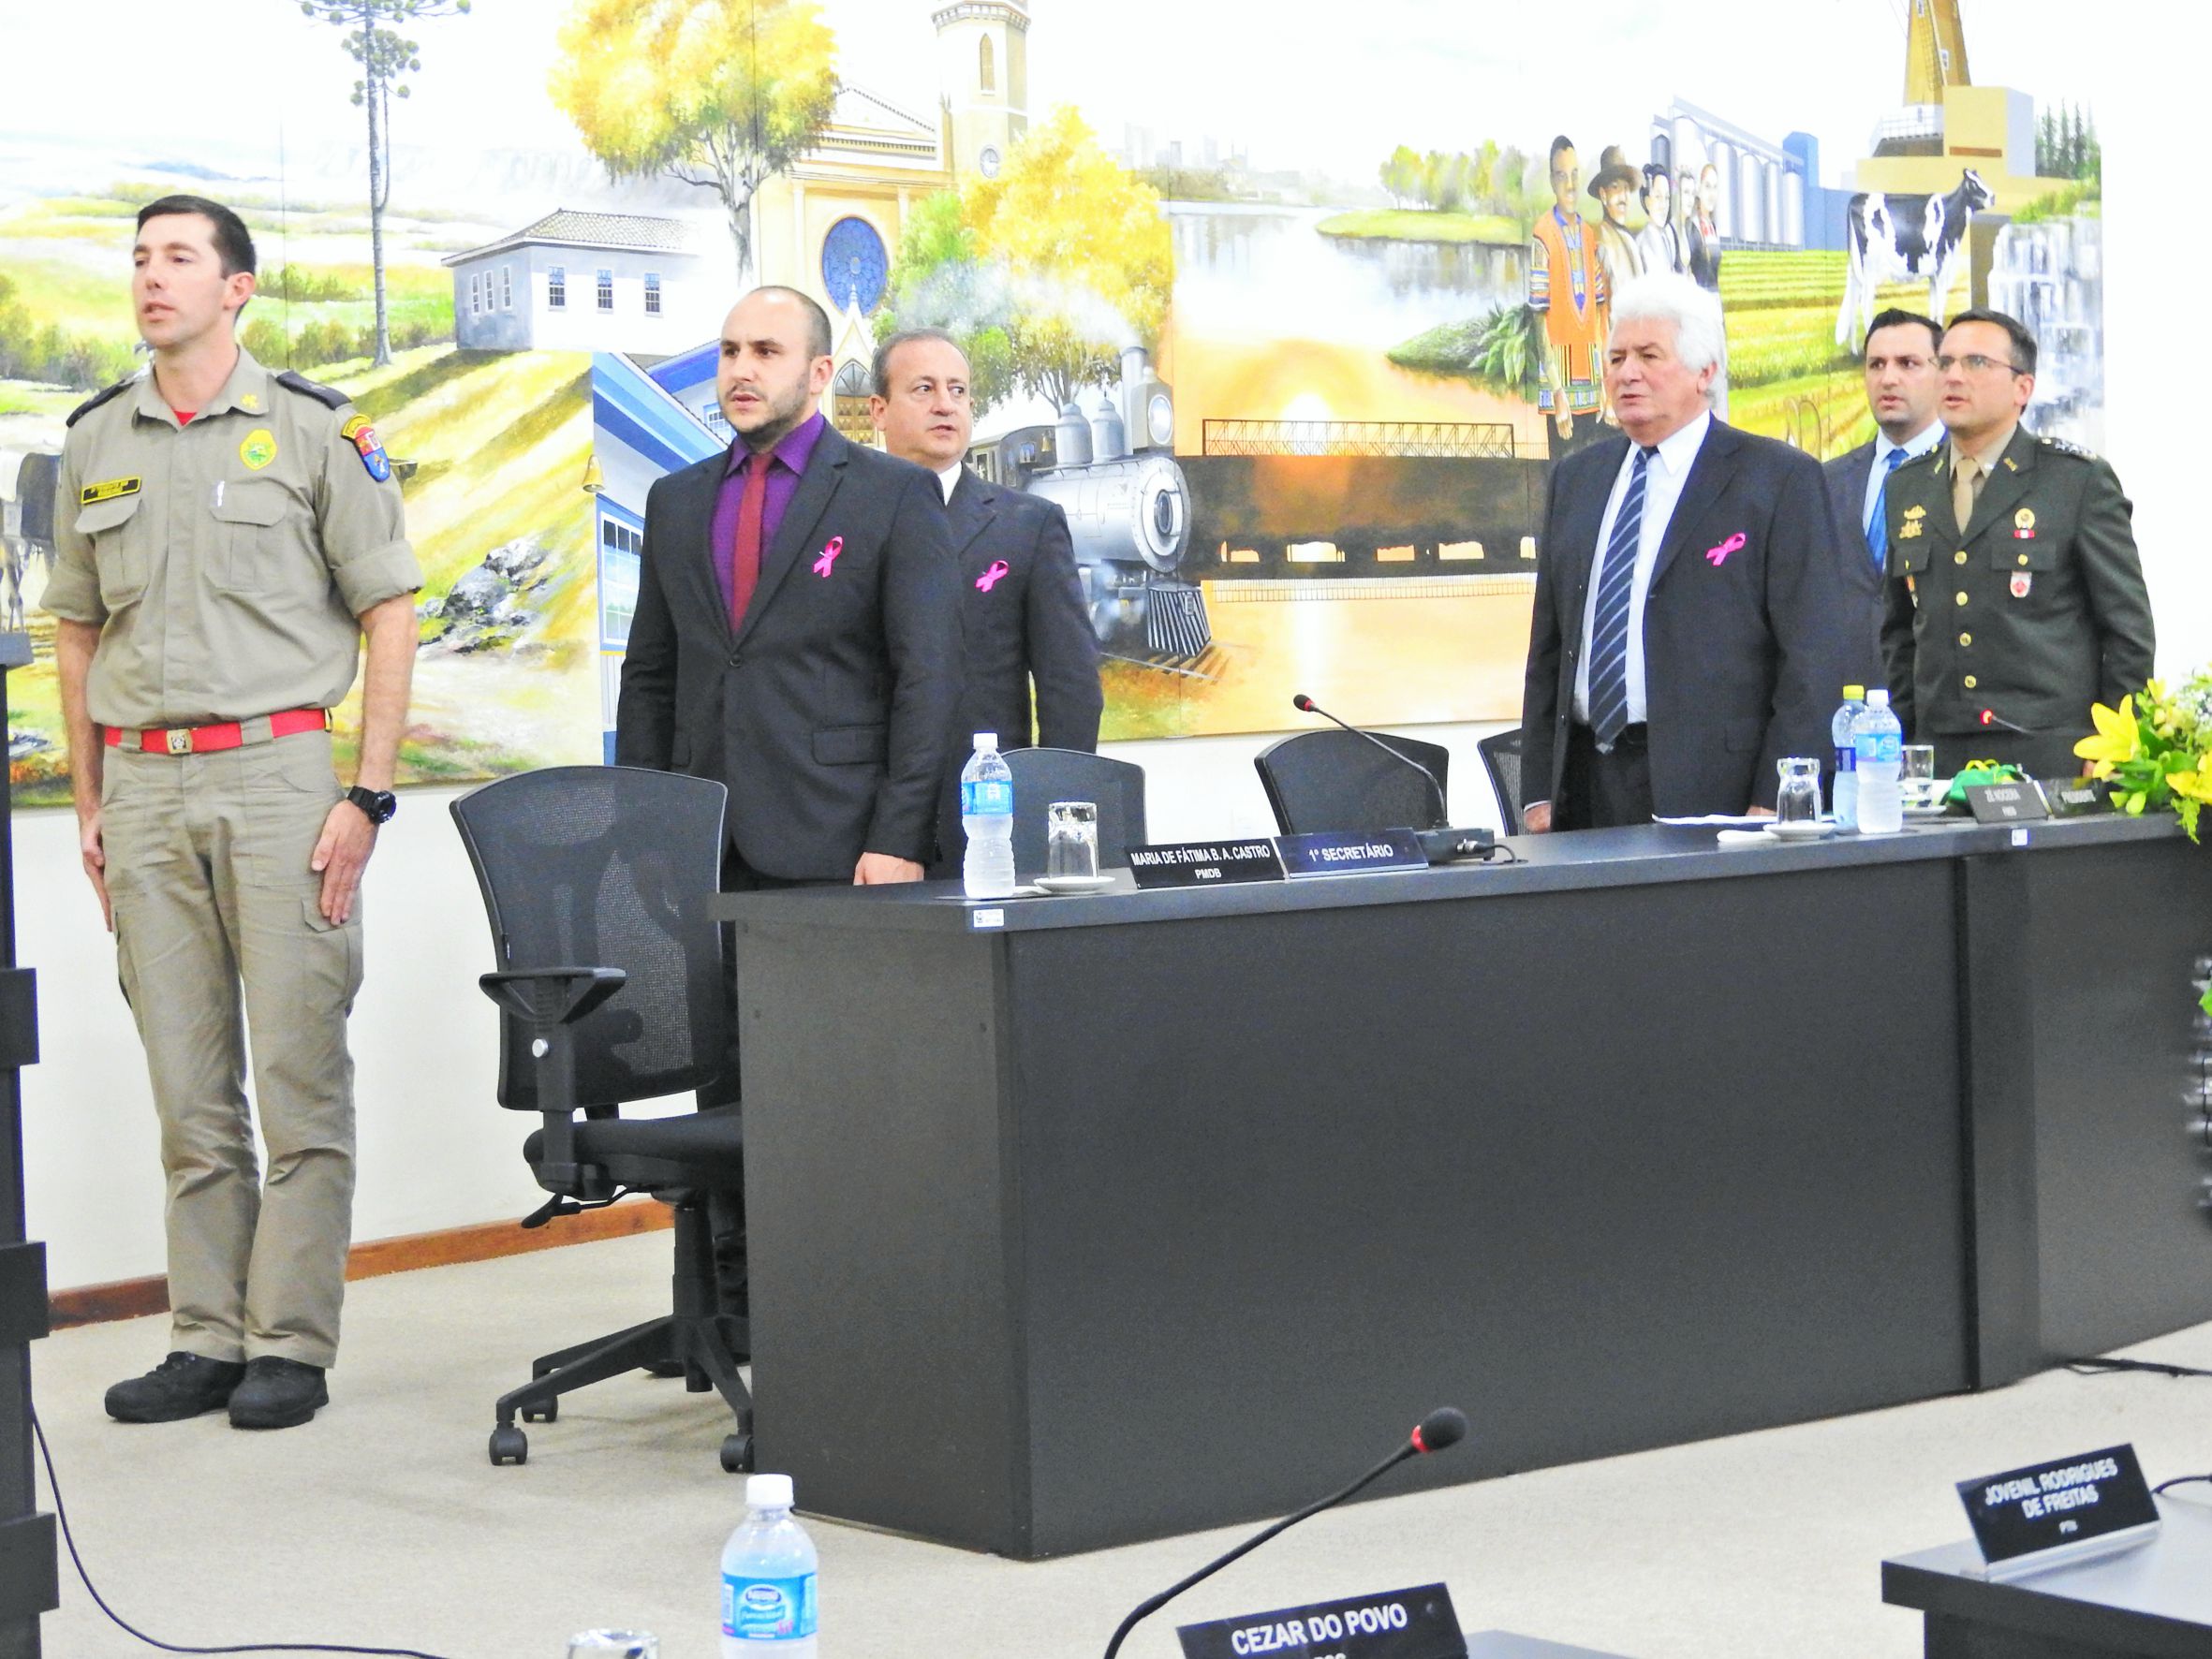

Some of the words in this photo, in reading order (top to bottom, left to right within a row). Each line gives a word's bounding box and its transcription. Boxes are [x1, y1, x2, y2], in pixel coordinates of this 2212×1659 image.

[1130, 850, 1164, 866] MARIA
[1164, 849, 1177, 863] DE
[1178, 846, 1214, 863] FÁTIMA
[1213, 847, 1221, 861] B.
[1222, 846, 1232, 860] A.
[1232, 844, 1271, 860] CASTRO
[1320, 843, 1394, 861] SECRETÁRIO
[1194, 867, 1222, 879] PMDB
[1985, 1476, 2040, 1505] JOVENIL
[2039, 1458, 2117, 1491] RODRIGUES
[2022, 1498, 2044, 1519] DE
[2044, 1484, 2100, 1514] FREITAS
[1231, 1620, 1308, 1655] CEZAR
[1307, 1613, 1343, 1643] DO
[1344, 1603, 1408, 1636] POVO
